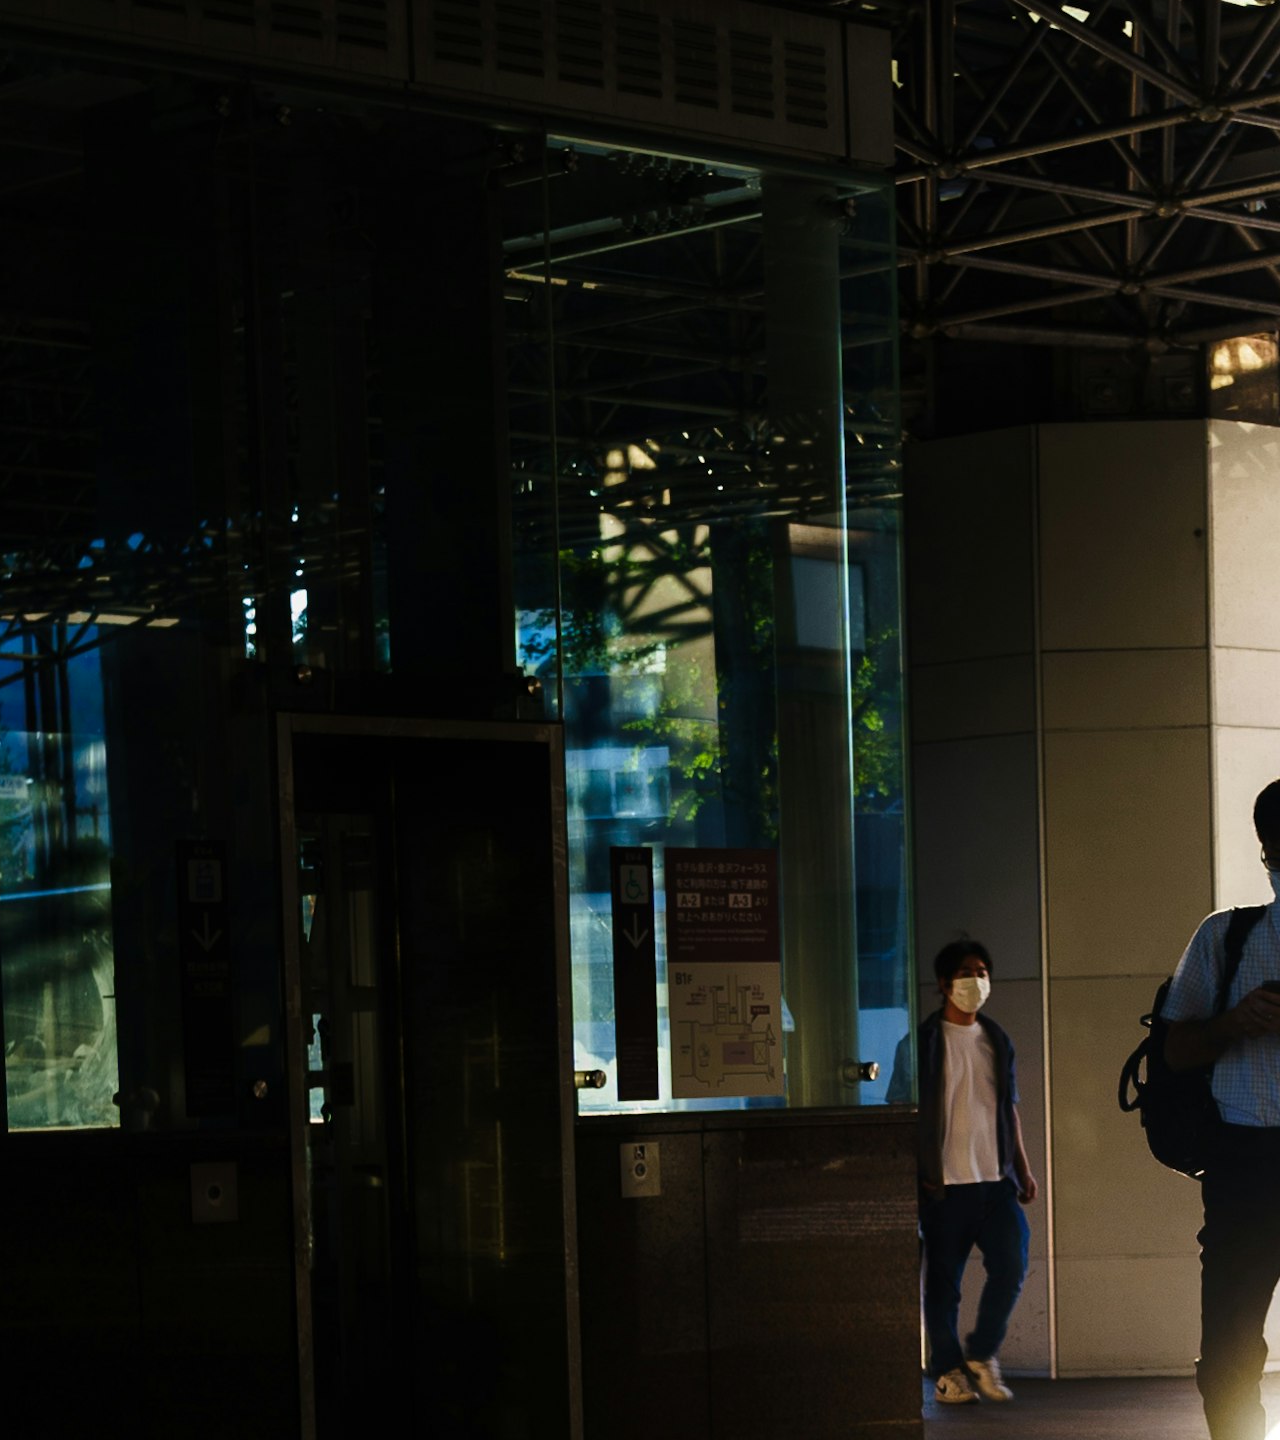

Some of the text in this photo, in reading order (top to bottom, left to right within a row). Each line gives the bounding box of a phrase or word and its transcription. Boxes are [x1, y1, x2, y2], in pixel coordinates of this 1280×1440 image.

[680, 895, 769, 907] A-2 または A-3 より
[675, 972, 693, 985] B1F
